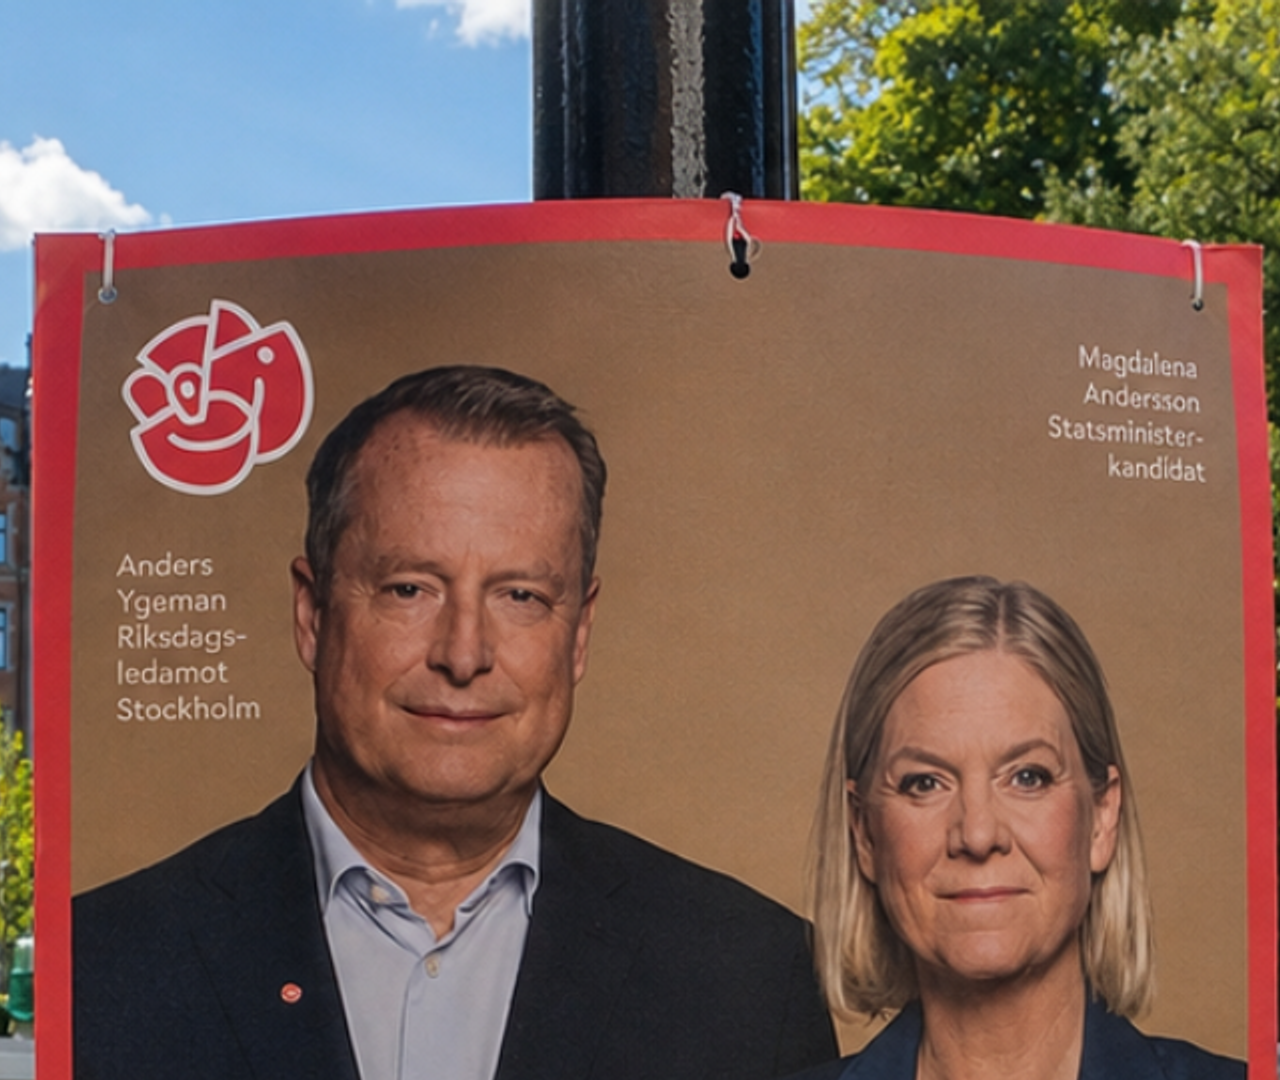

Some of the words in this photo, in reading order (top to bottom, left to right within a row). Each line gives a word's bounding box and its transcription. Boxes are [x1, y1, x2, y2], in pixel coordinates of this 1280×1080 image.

[1078, 345, 1198, 379] Magdalena
[1083, 382, 1200, 413] Andersson
[1047, 414, 1204, 447] Statsminister-
[1108, 453, 1207, 483] kandidat
[116, 551, 213, 577] Anders
[117, 588, 227, 620] Ygeman
[117, 623, 247, 653] Riksdags-
[117, 658, 228, 685] ledamot
[116, 694, 261, 721] Stockholm
